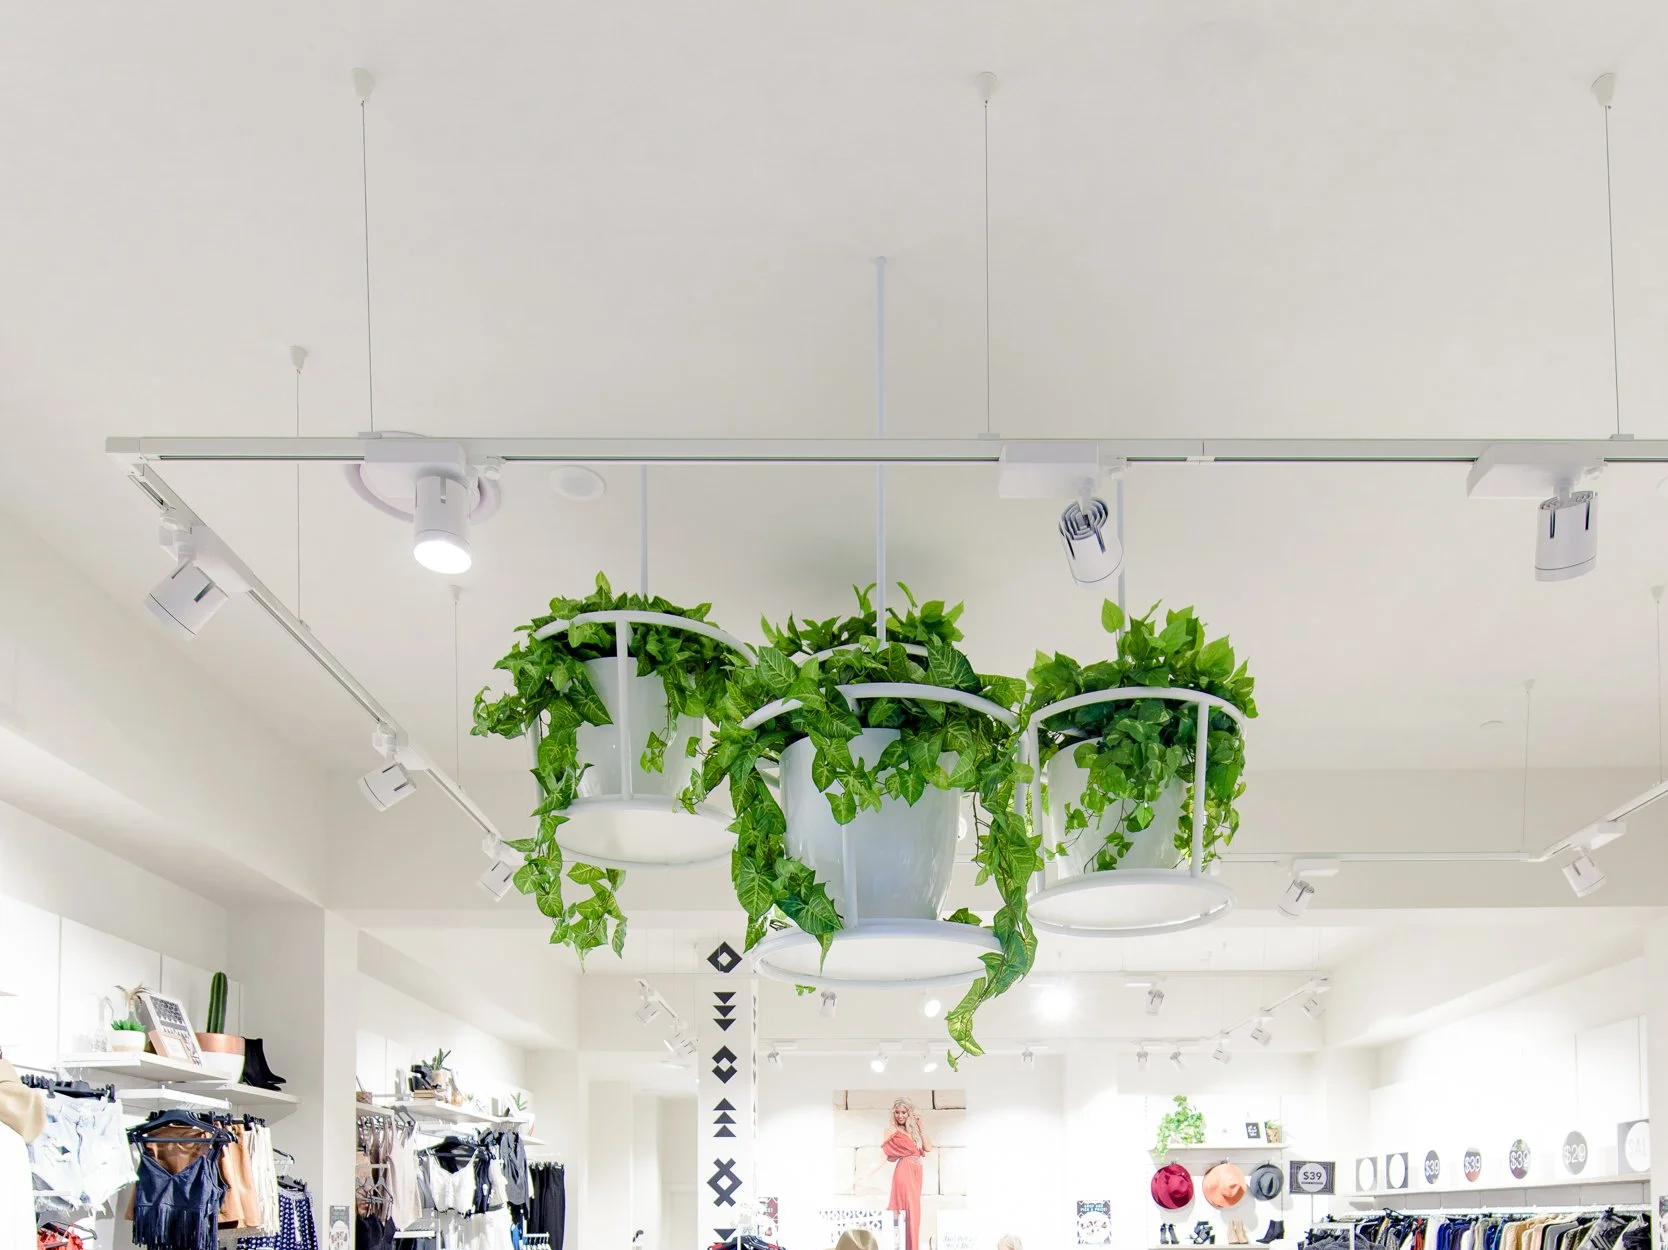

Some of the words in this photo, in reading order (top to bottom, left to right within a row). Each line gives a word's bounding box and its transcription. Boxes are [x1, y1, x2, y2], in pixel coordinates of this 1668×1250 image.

[1510, 1151, 1530, 1169] $39
[1564, 1143, 1586, 1164] $29
[1425, 1159, 1440, 1176] $39
[1464, 1155, 1481, 1173] $39
[1302, 1171, 1322, 1181] $39
